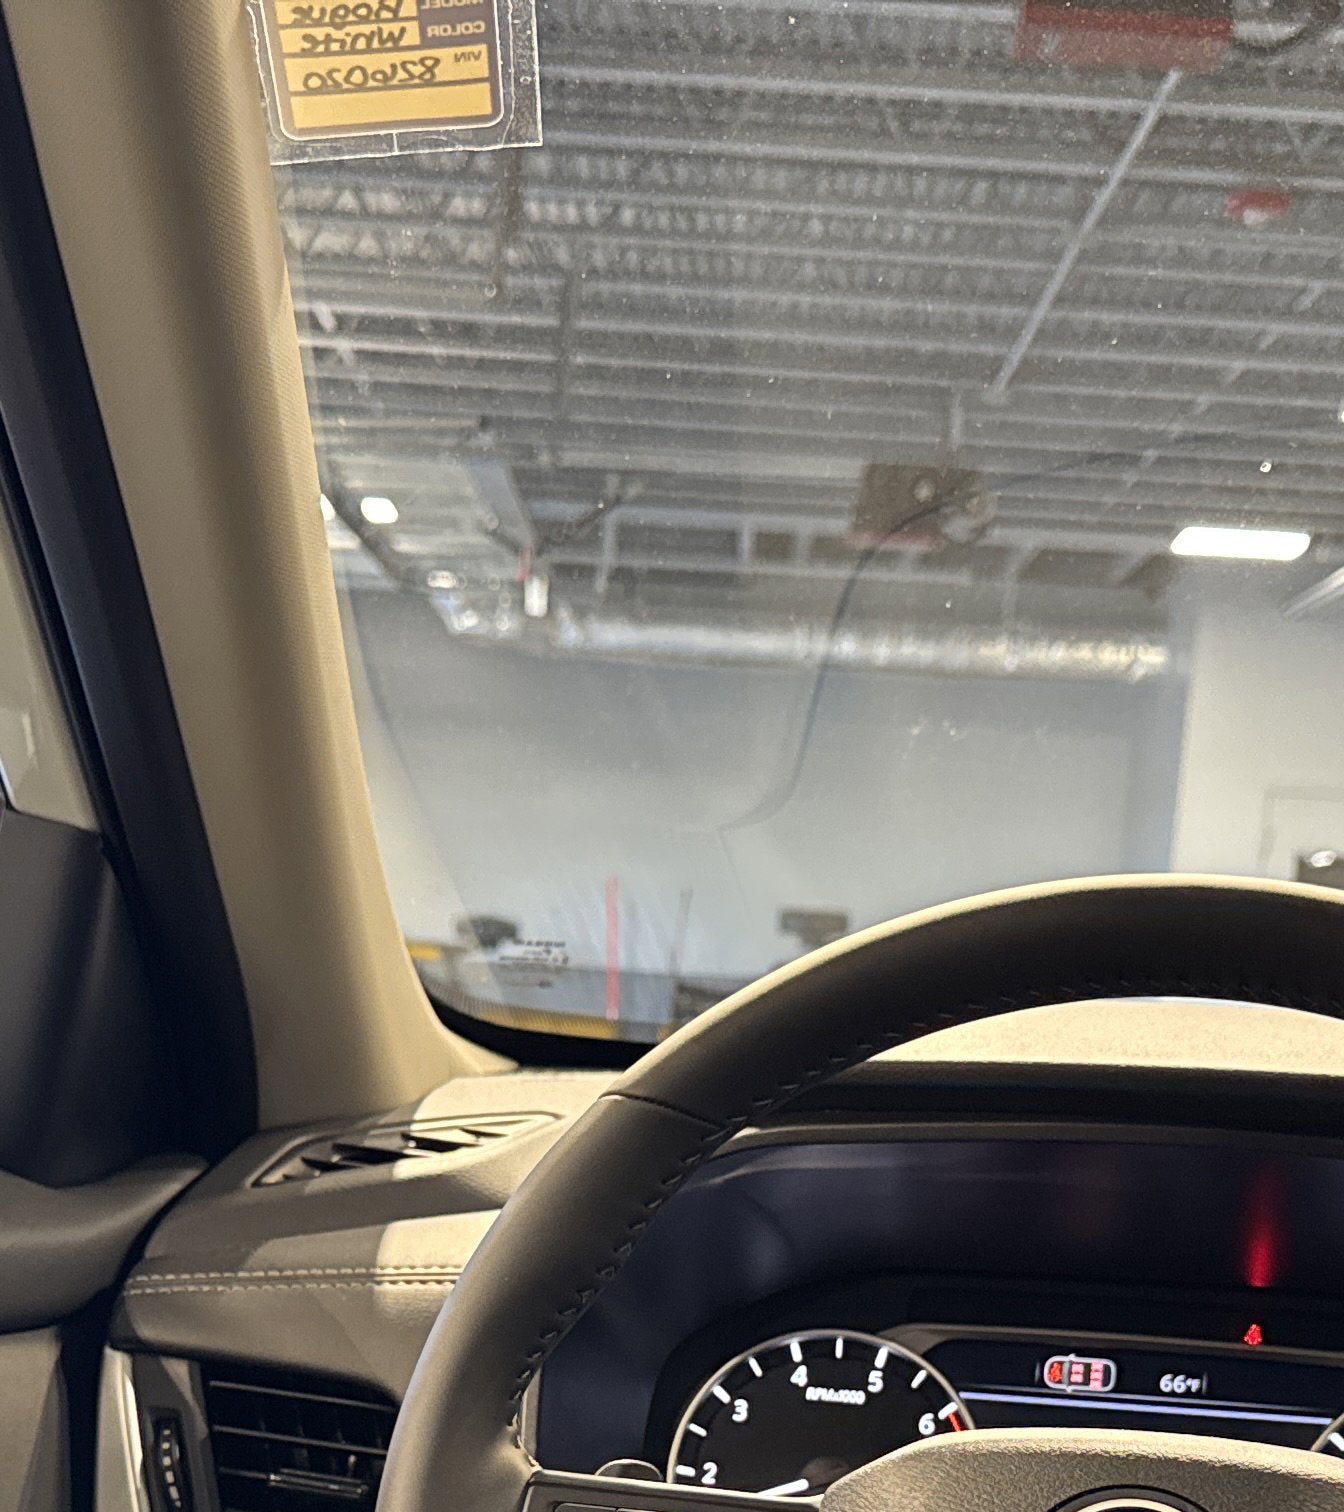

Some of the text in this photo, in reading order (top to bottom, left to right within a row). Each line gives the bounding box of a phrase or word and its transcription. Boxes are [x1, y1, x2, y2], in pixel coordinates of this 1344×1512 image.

[790, 1365, 807, 1387] 4
[867, 1370, 883, 1393] 5
[732, 1399, 748, 1422] 3
[918, 1413, 935, 1435] 6
[702, 1462, 718, 1484] 2
